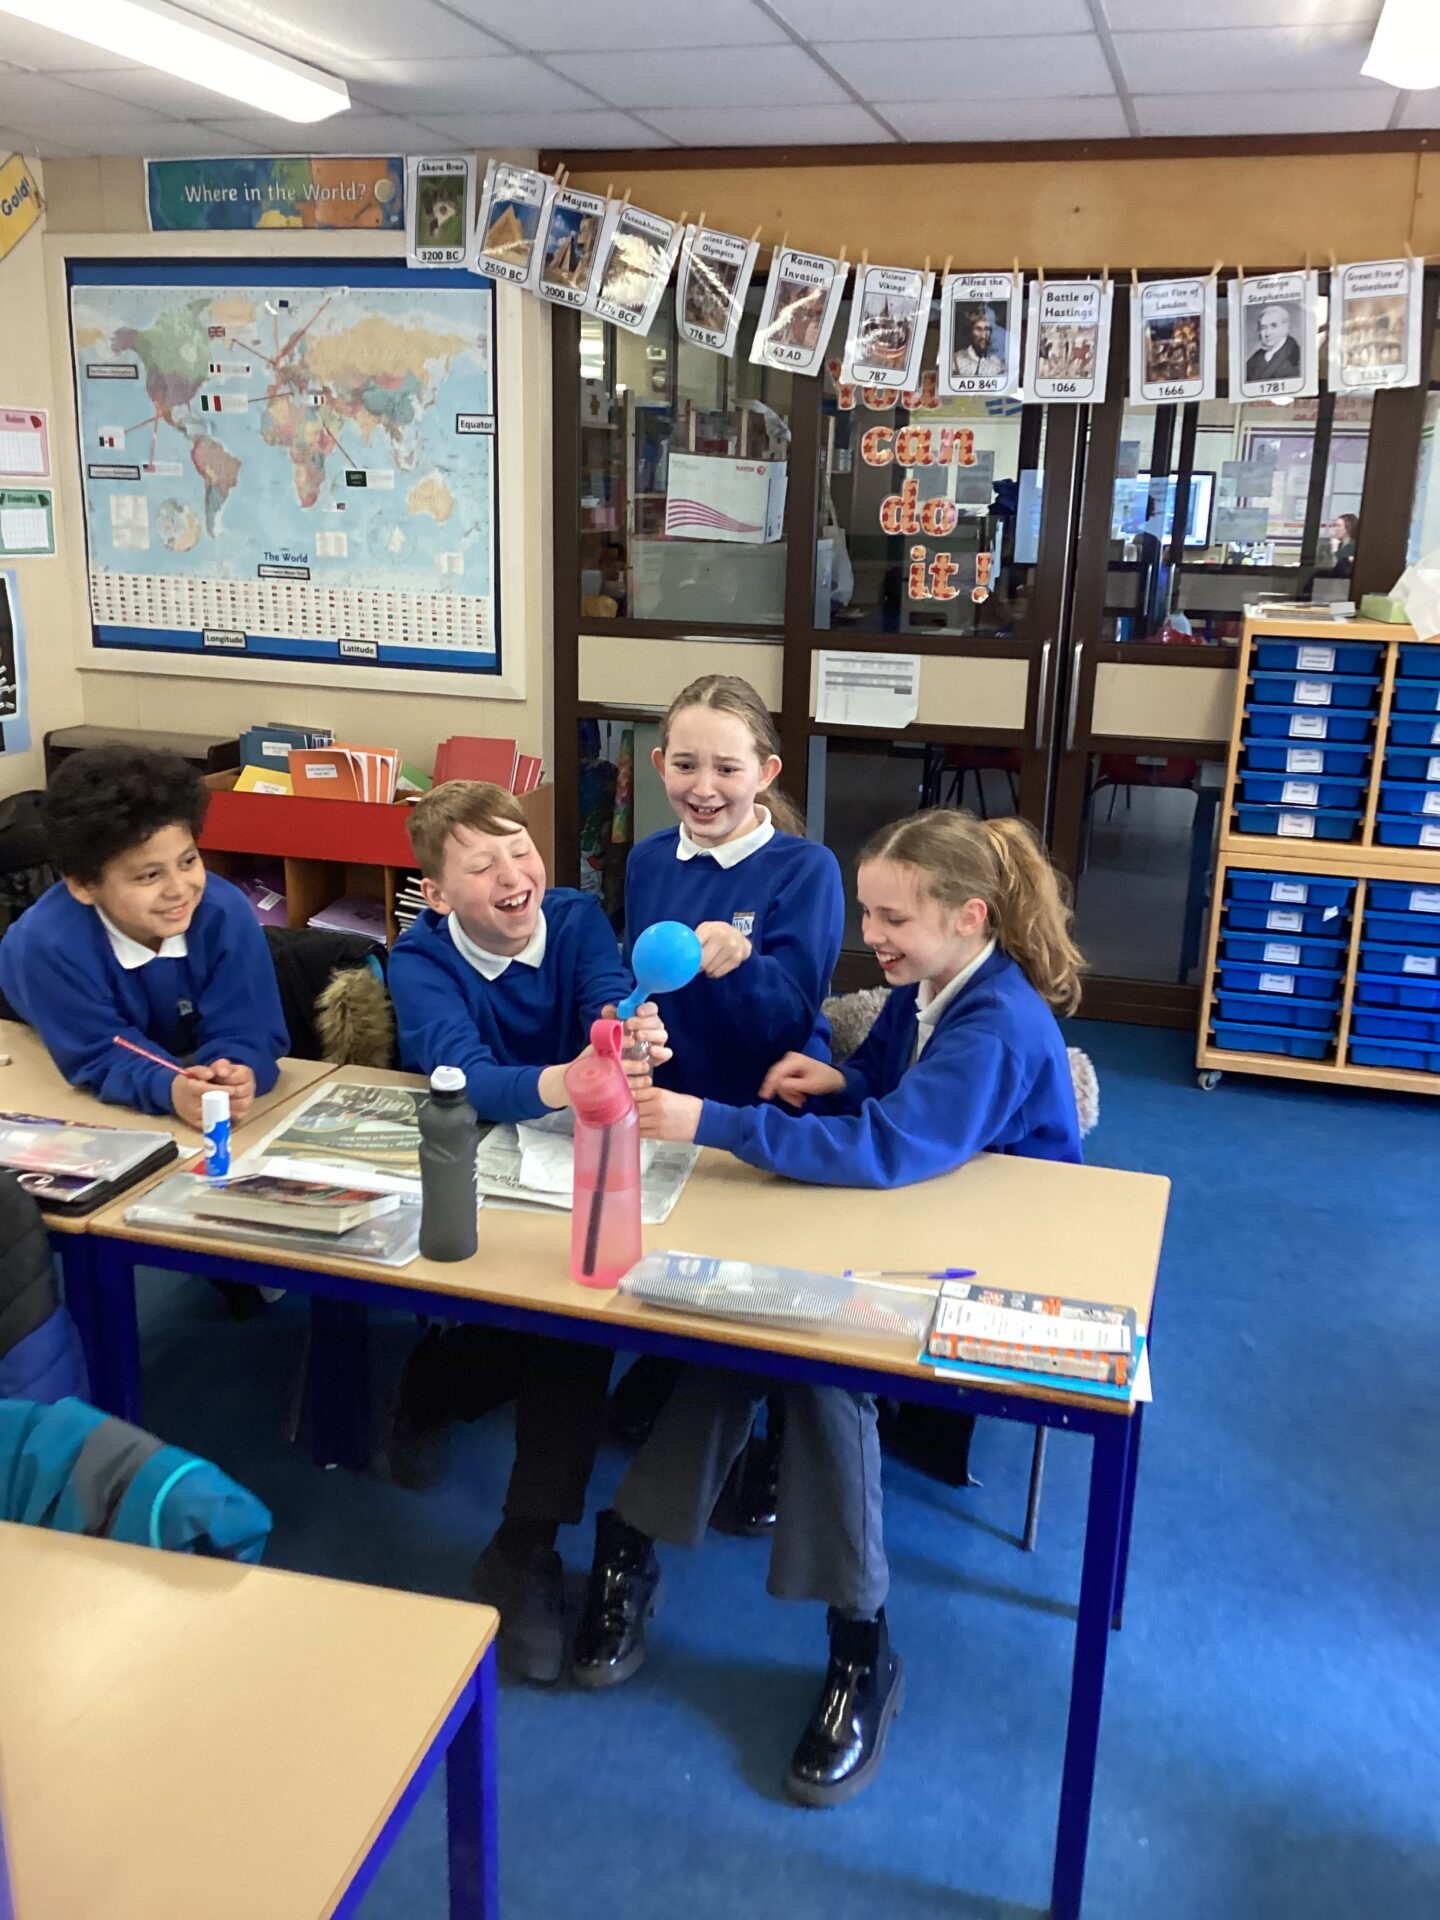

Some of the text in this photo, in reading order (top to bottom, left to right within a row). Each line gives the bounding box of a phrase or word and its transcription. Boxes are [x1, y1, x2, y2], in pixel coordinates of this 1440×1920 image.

[421, 163, 444, 172] Skara
[185, 180, 367, 202] Where in the World?
[562, 193, 598, 210] Mayans
[421, 251, 459, 260] 3200 BC
[702, 244, 735, 258] Olympics
[790, 253, 825, 270] Roman
[485, 261, 522, 281] 2550 BC
[1375, 270, 1393, 279] Fire
[1396, 268, 1405, 280] of
[878, 281, 906, 293] Vikings
[961, 276, 1003, 287] Alfred the
[1256, 280, 1290, 291] George
[545, 285, 581, 303] 2000 BC
[1046, 292, 1094, 305] Battle of
[1171, 288, 1188, 297] Fire
[1190, 287, 1199, 298] of
[1248, 291, 1302, 304] Stephenson
[618, 308, 638, 325] BCE
[1045, 307, 1093, 321] Hastings
[689, 327, 717, 345] 776 BC
[773, 347, 801, 361] 43 AD
[868, 371, 887, 382] 787
[958, 379, 998, 390] AD 849
[1051, 382, 1077, 393] 1066
[1259, 382, 1286, 394] 1781
[1158, 385, 1185, 397] 1666
[460, 420, 493, 430] Equator
[861, 426, 977, 467] can
[879, 478, 958, 536] do
[264, 552, 308, 563] The World
[206, 634, 244, 644] Longitude
[343, 644, 375, 655] Latitude
